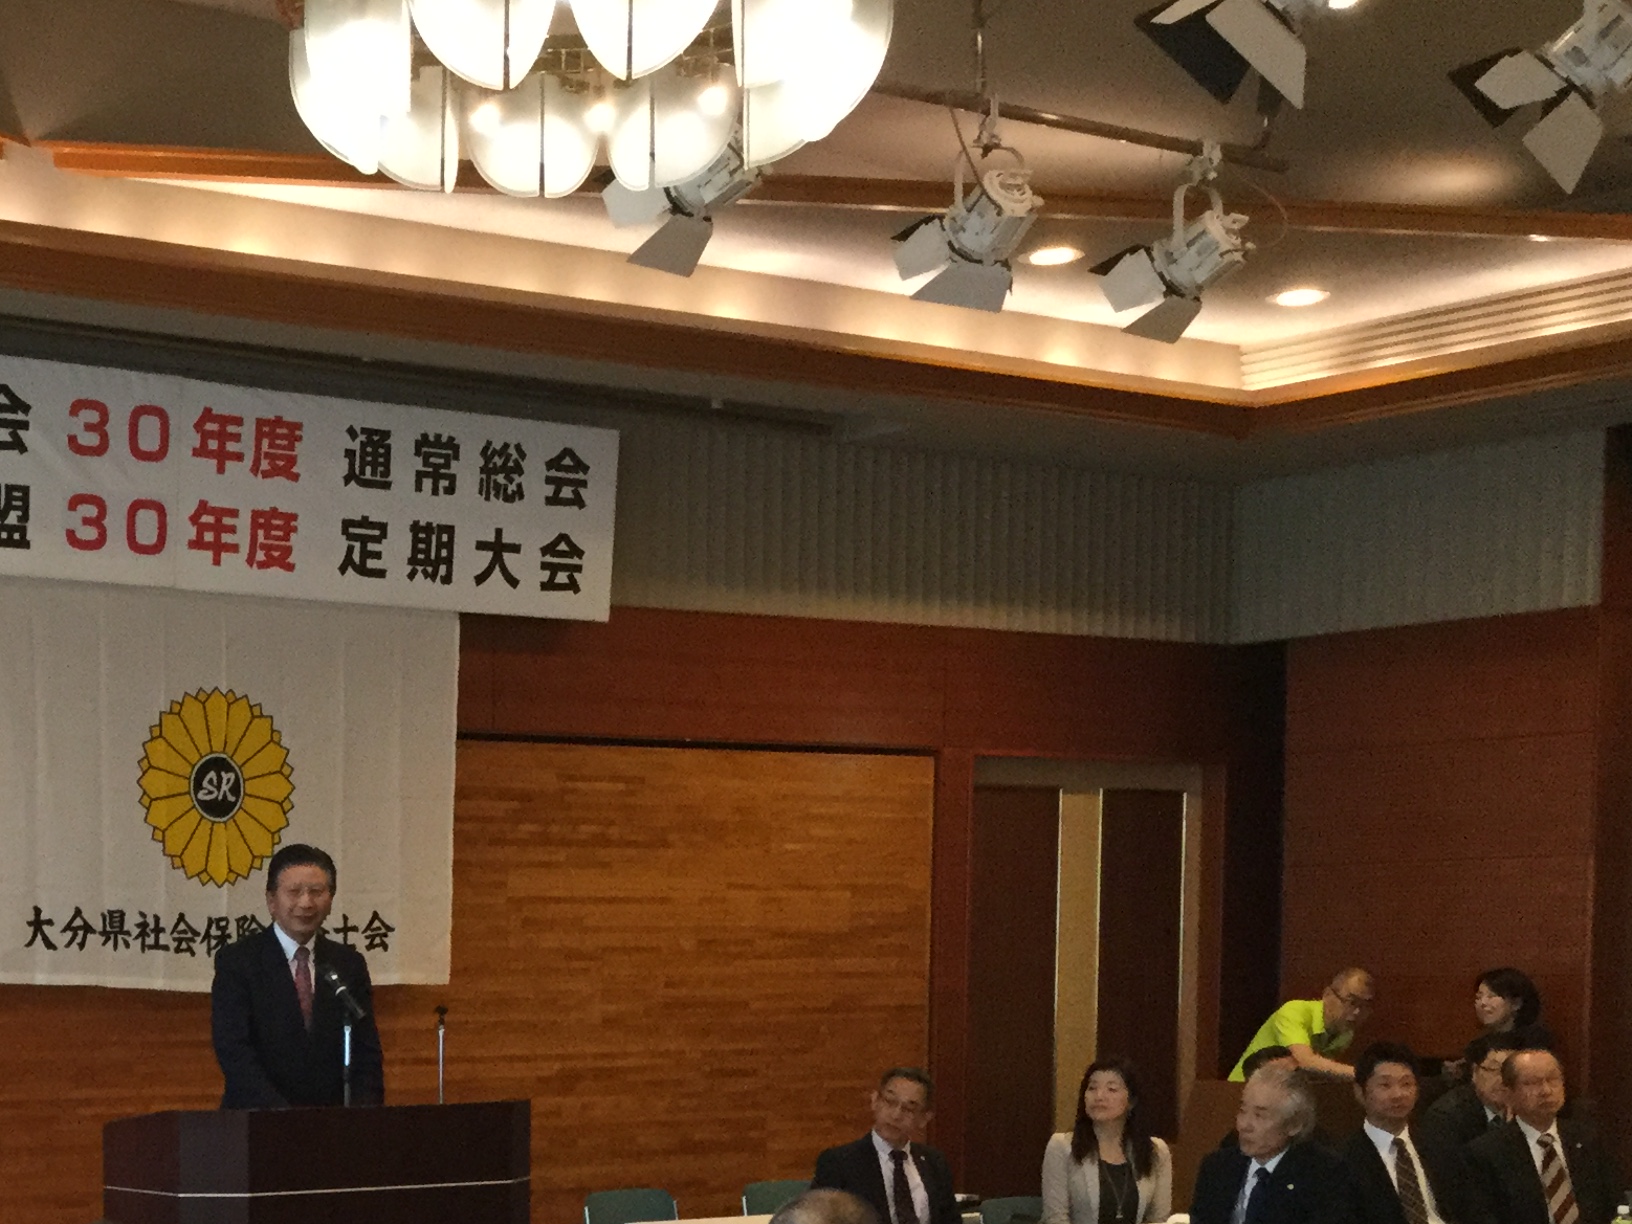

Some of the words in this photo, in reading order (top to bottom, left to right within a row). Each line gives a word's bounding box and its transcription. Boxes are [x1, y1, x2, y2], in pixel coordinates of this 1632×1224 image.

[67, 398, 304, 483] 30年度
[343, 425, 591, 510] 通常総会
[65, 493, 299, 573] 30年度
[338, 515, 586, 596] 定期大会
[196, 769, 237, 803] SR
[24, 905, 396, 957] 大分県社会保険士会
